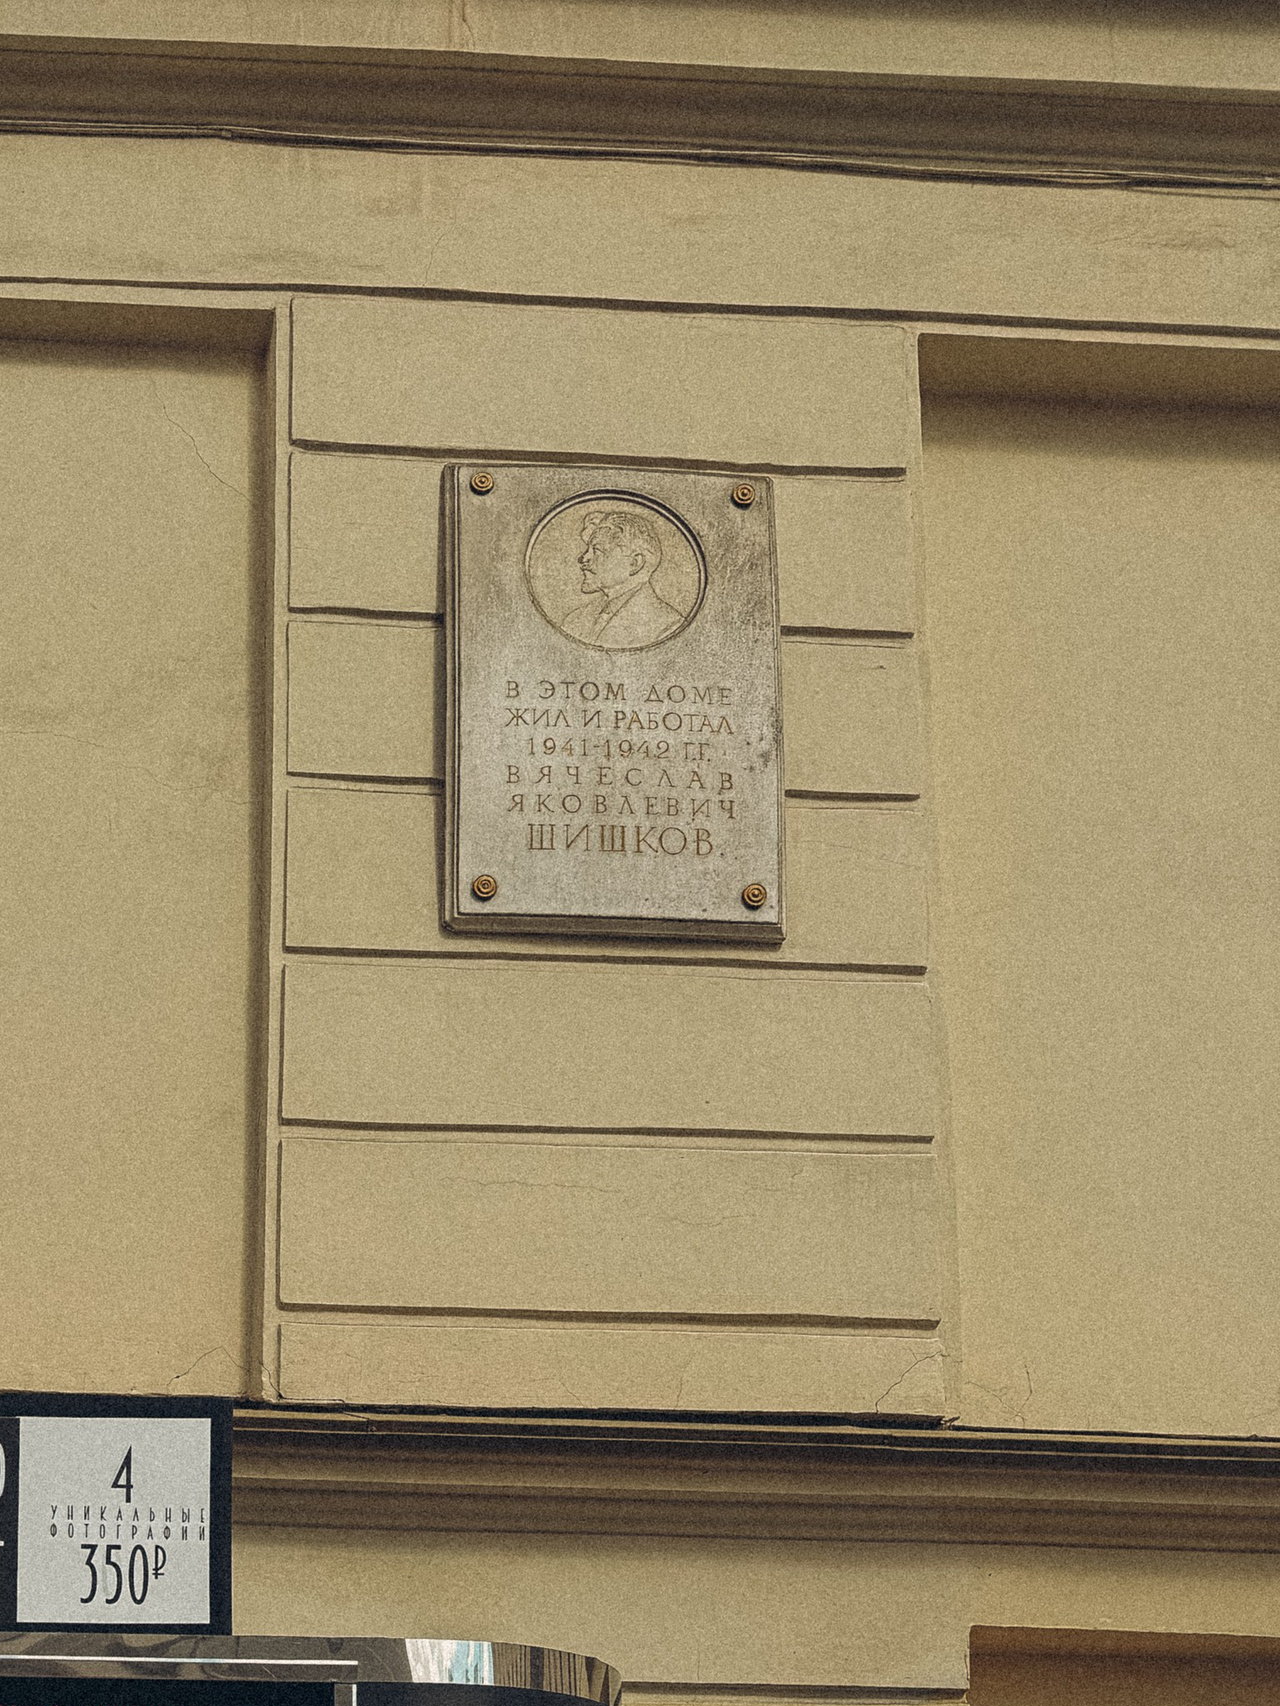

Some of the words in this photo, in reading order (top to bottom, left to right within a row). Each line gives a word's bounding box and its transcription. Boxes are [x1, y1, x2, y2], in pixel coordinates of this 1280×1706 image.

[506, 680, 520, 699] В
[538, 680, 627, 701] ЭТОМ
[645, 684, 732, 705] ДОМЕ
[505, 708, 571, 727] ЖИЛ
[582, 709, 602, 728] И
[614, 710, 735, 734] РАБОТАЛ
[506, 765, 734, 791] ВЯЧЕСЛАВ
[507, 794, 736, 820] ЯКОВЛЕВИЧ
[528, 823, 713, 856] ШИШКОВ
[110, 1445, 134, 1504] 4
[50, 1504, 206, 1523] УНИКАЛЬНЫЕ
[49, 1523, 206, 1541] ФОТОГРАФИИ
